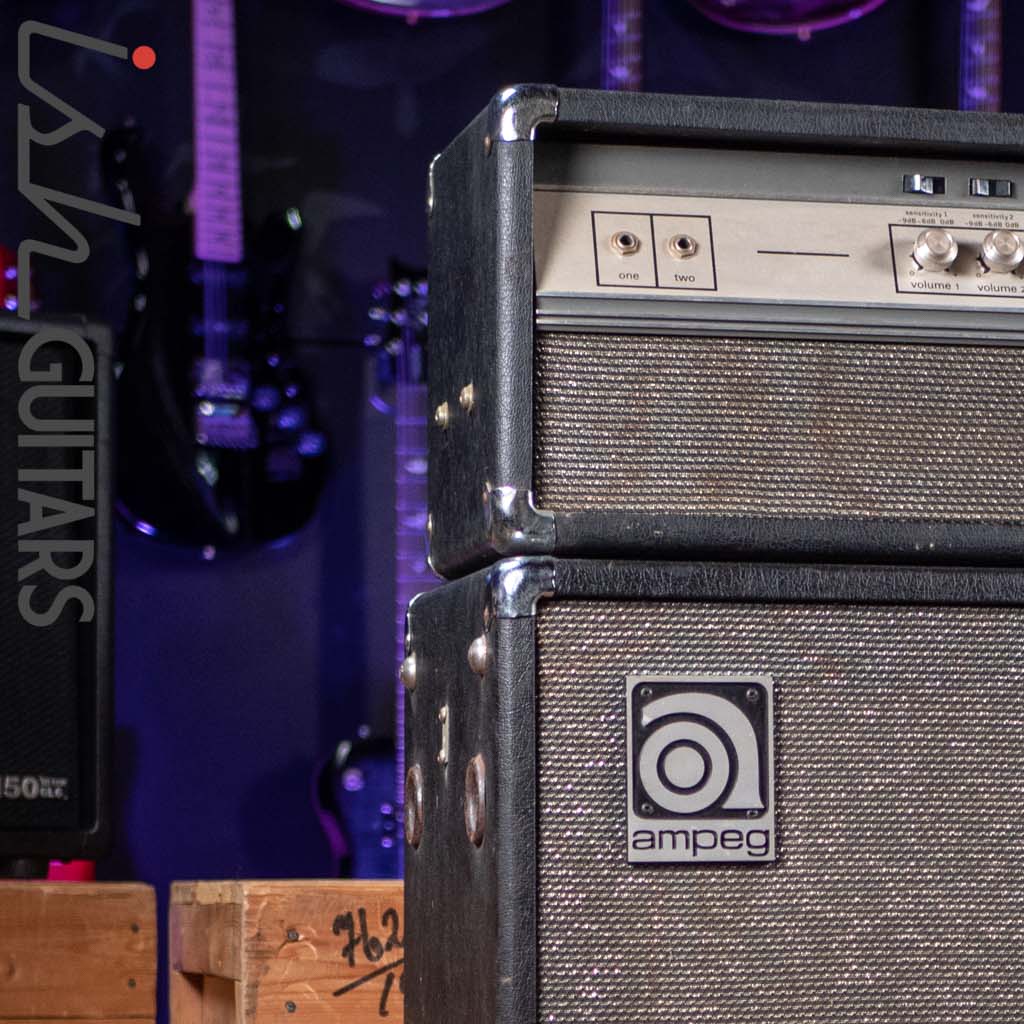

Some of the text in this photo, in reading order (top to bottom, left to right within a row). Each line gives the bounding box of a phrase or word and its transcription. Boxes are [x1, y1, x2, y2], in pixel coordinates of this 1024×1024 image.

[618, 272, 640, 280] one
[674, 273, 696, 282] two
[910, 280, 952, 290] volume
[977, 283, 1018, 293] volume
[632, 828, 770, 857] ampeg
